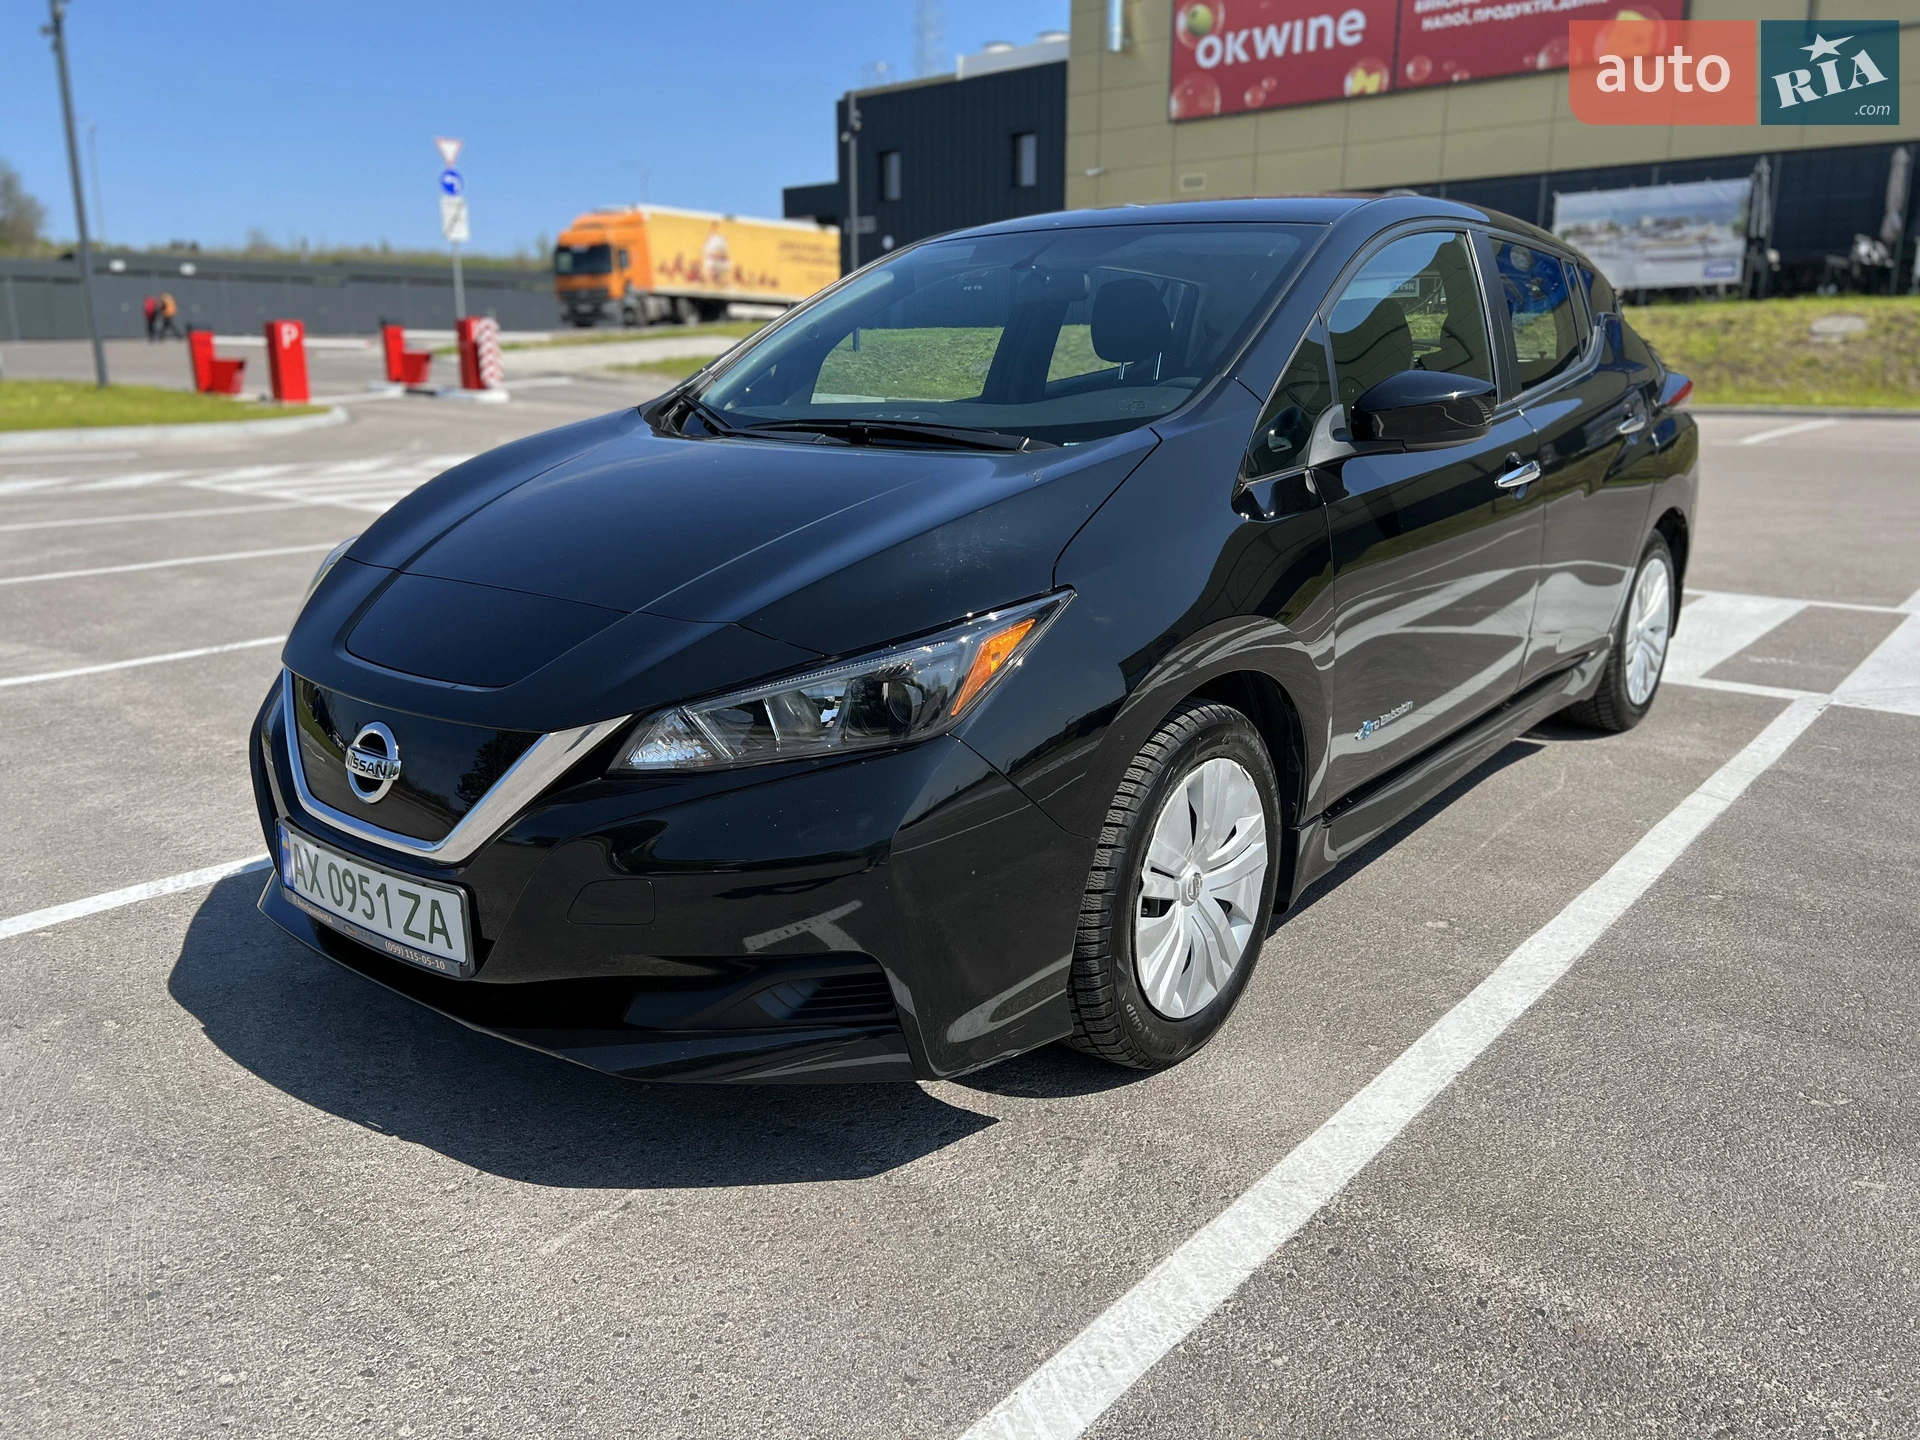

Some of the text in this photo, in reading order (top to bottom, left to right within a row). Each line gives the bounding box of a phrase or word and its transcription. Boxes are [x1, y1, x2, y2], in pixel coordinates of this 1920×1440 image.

[281, 322, 299, 350] P
[346, 750, 388, 777] NISSAN
[293, 843, 325, 900] AX
[328, 861, 393, 930] 0951
[397, 888, 453, 950] ZA
[385, 940, 446, 970] (099) 115-05-10
